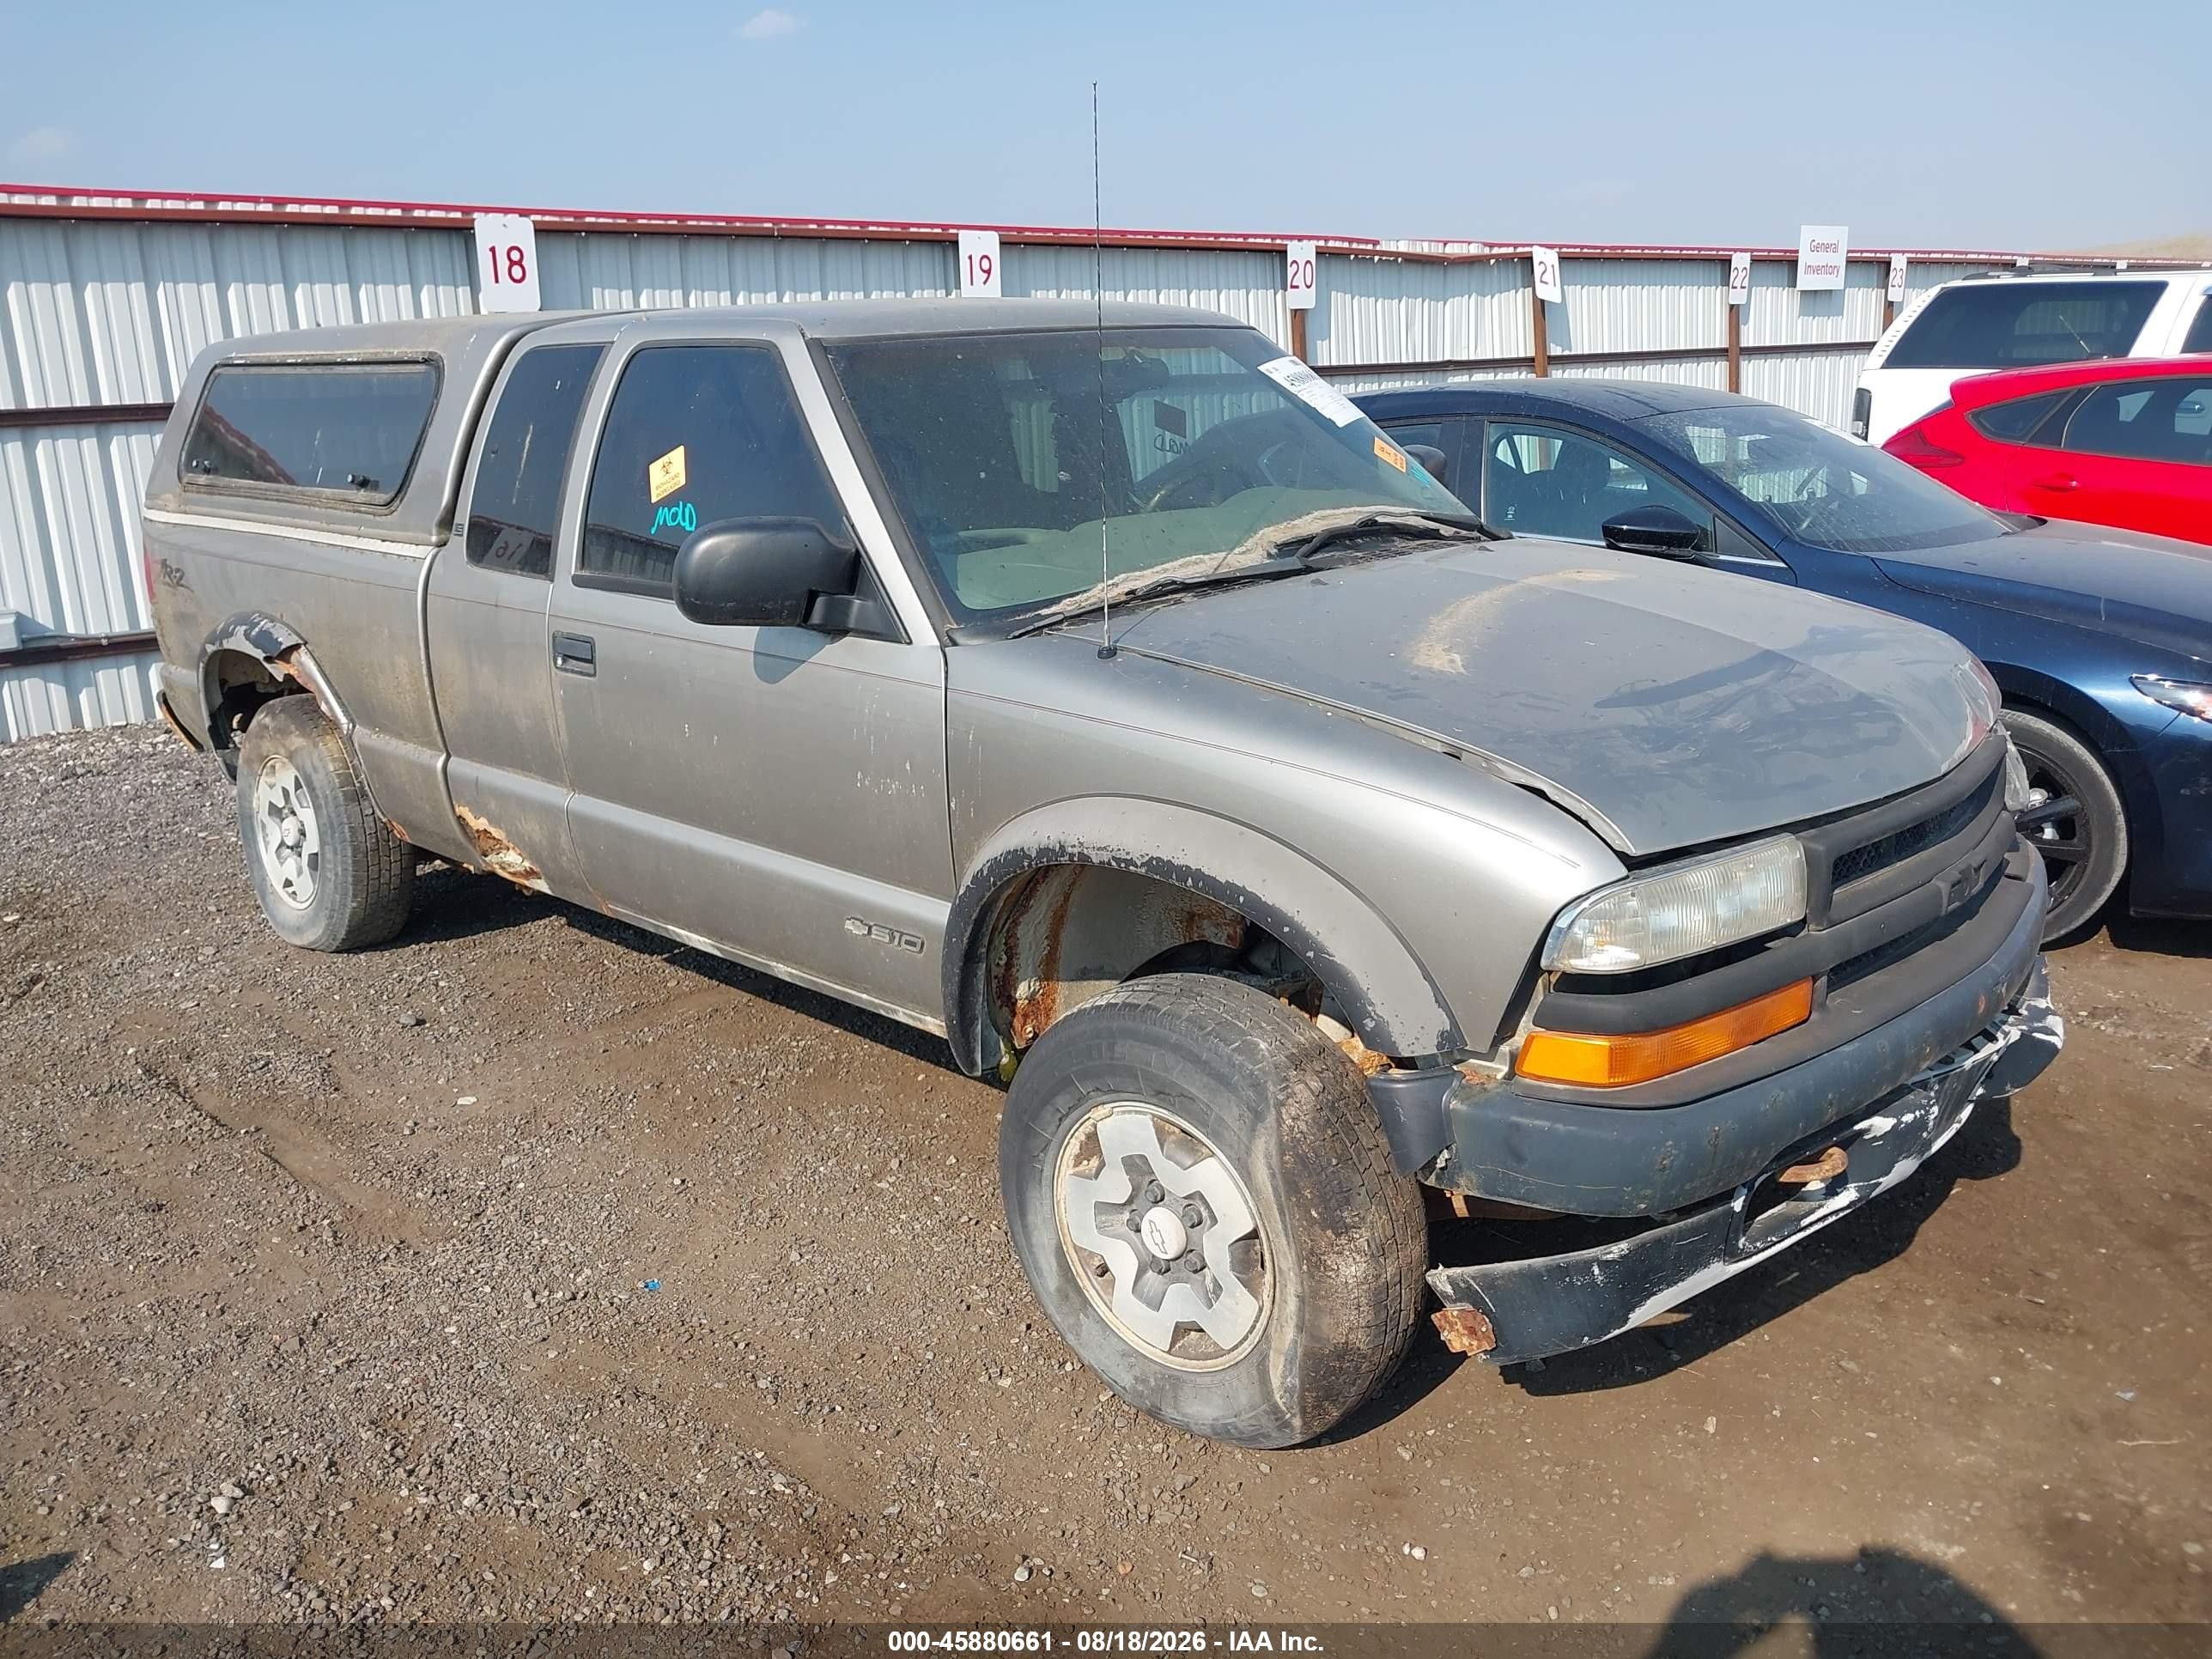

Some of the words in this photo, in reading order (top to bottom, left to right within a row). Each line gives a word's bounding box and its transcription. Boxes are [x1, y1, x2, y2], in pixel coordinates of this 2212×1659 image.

[1809, 239, 1839, 253] General
[489, 246, 526, 284] 18
[967, 253, 993, 286] 19
[1290, 259, 1314, 289] 20
[1538, 260, 1557, 288] 21
[1731, 266, 1748, 289] 22
[1804, 261, 1840, 278] Inventory
[1890, 267, 1905, 289] 23
